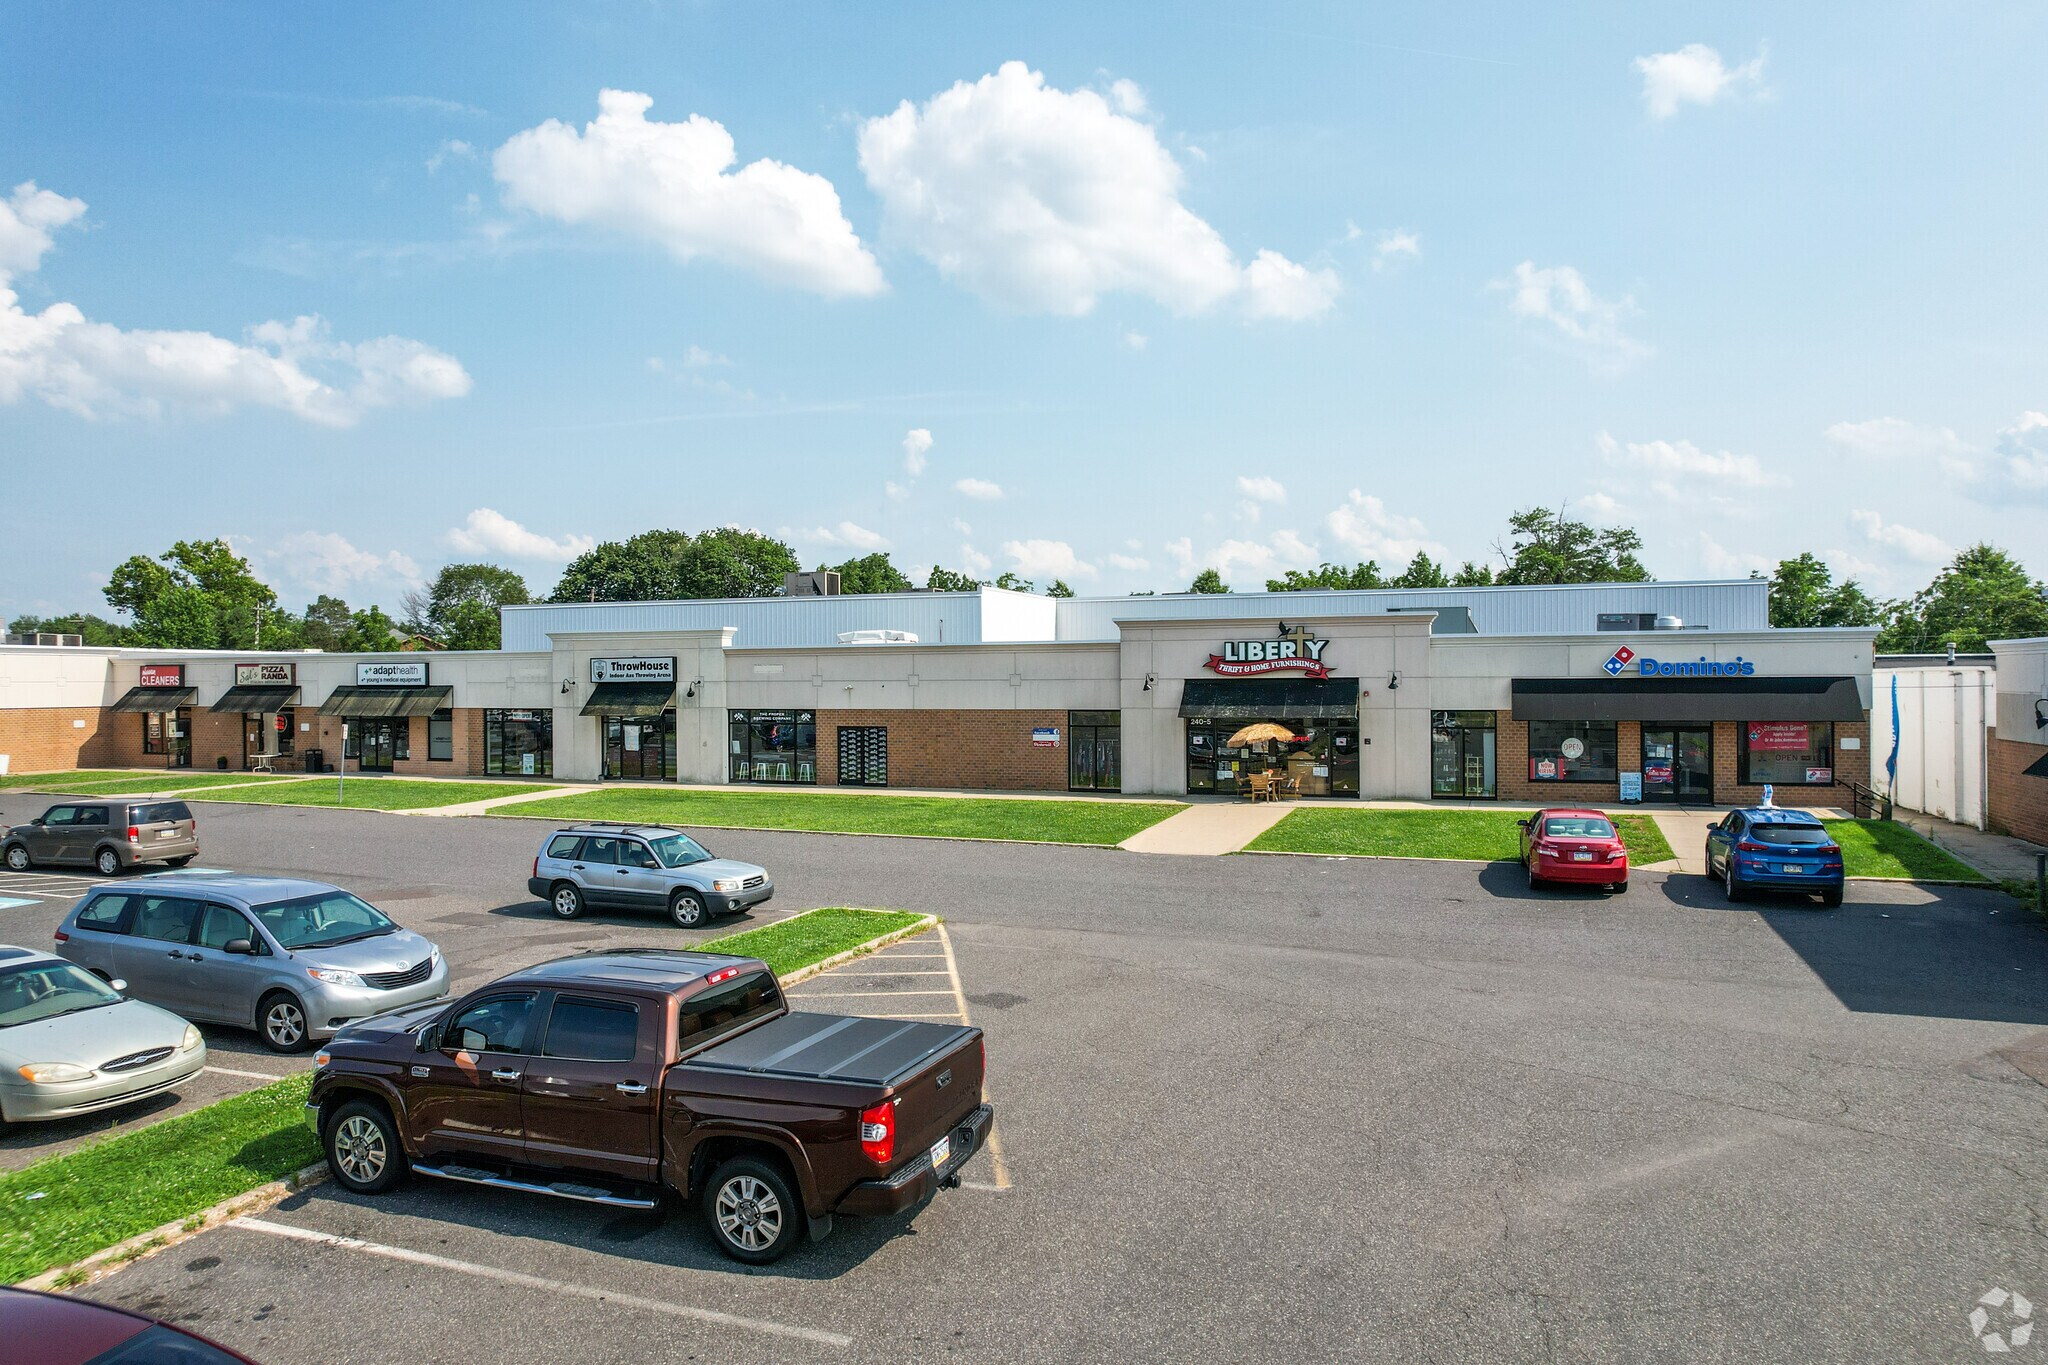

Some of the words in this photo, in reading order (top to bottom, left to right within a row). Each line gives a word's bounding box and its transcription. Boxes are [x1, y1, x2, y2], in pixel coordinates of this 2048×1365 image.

[1224, 626, 1329, 661] LIBERTY
[373, 666, 418, 676] adapthealth
[611, 661, 669, 671] ThrowHouse
[1219, 663, 1243, 673] THRIFT
[1244, 664, 1250, 672] &
[1251, 662, 1270, 672] HOME
[1271, 660, 1320, 670] FURNISHINGS
[1640, 656, 1755, 676] Domino's
[141, 676, 179, 685] CLEANERS
[240, 667, 258, 683] Sal's
